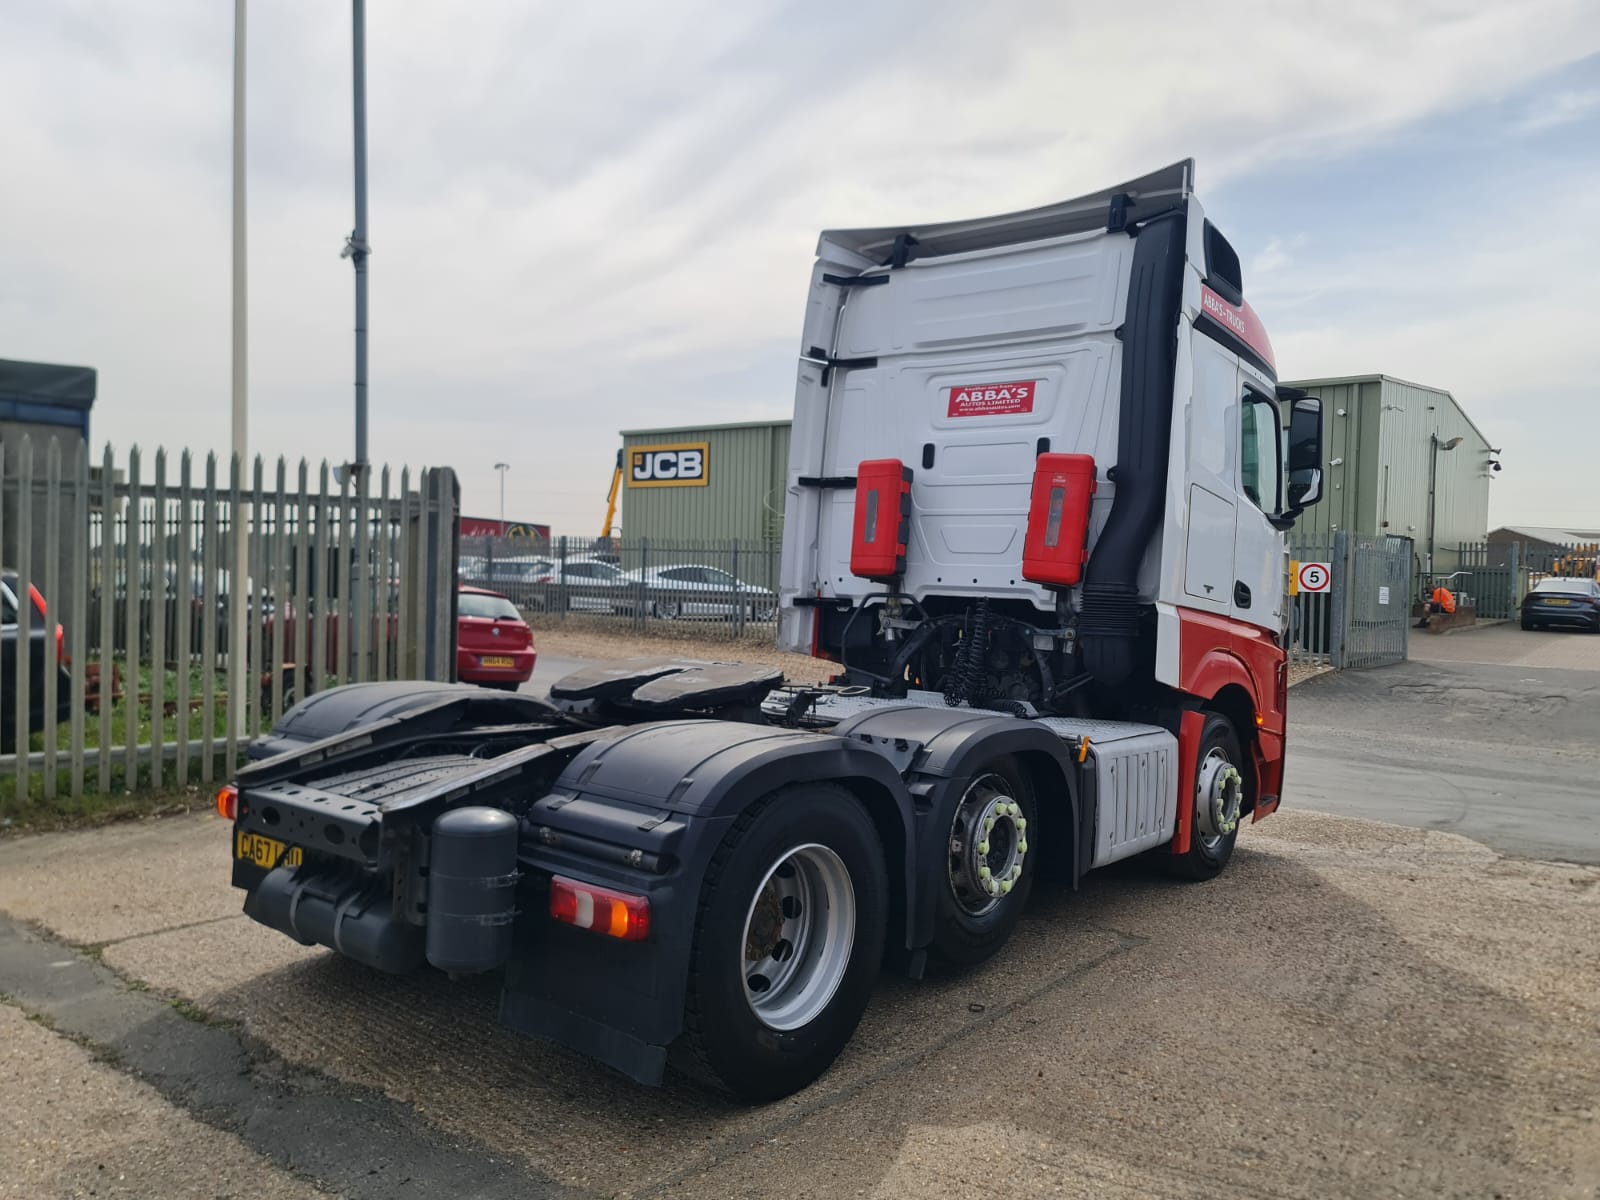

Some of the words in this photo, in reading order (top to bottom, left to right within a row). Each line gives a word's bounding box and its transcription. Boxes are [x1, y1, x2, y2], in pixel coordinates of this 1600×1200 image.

[955, 388, 1029, 403] ABBA'S
[633, 450, 702, 479] JCB
[1310, 571, 1320, 583] 5
